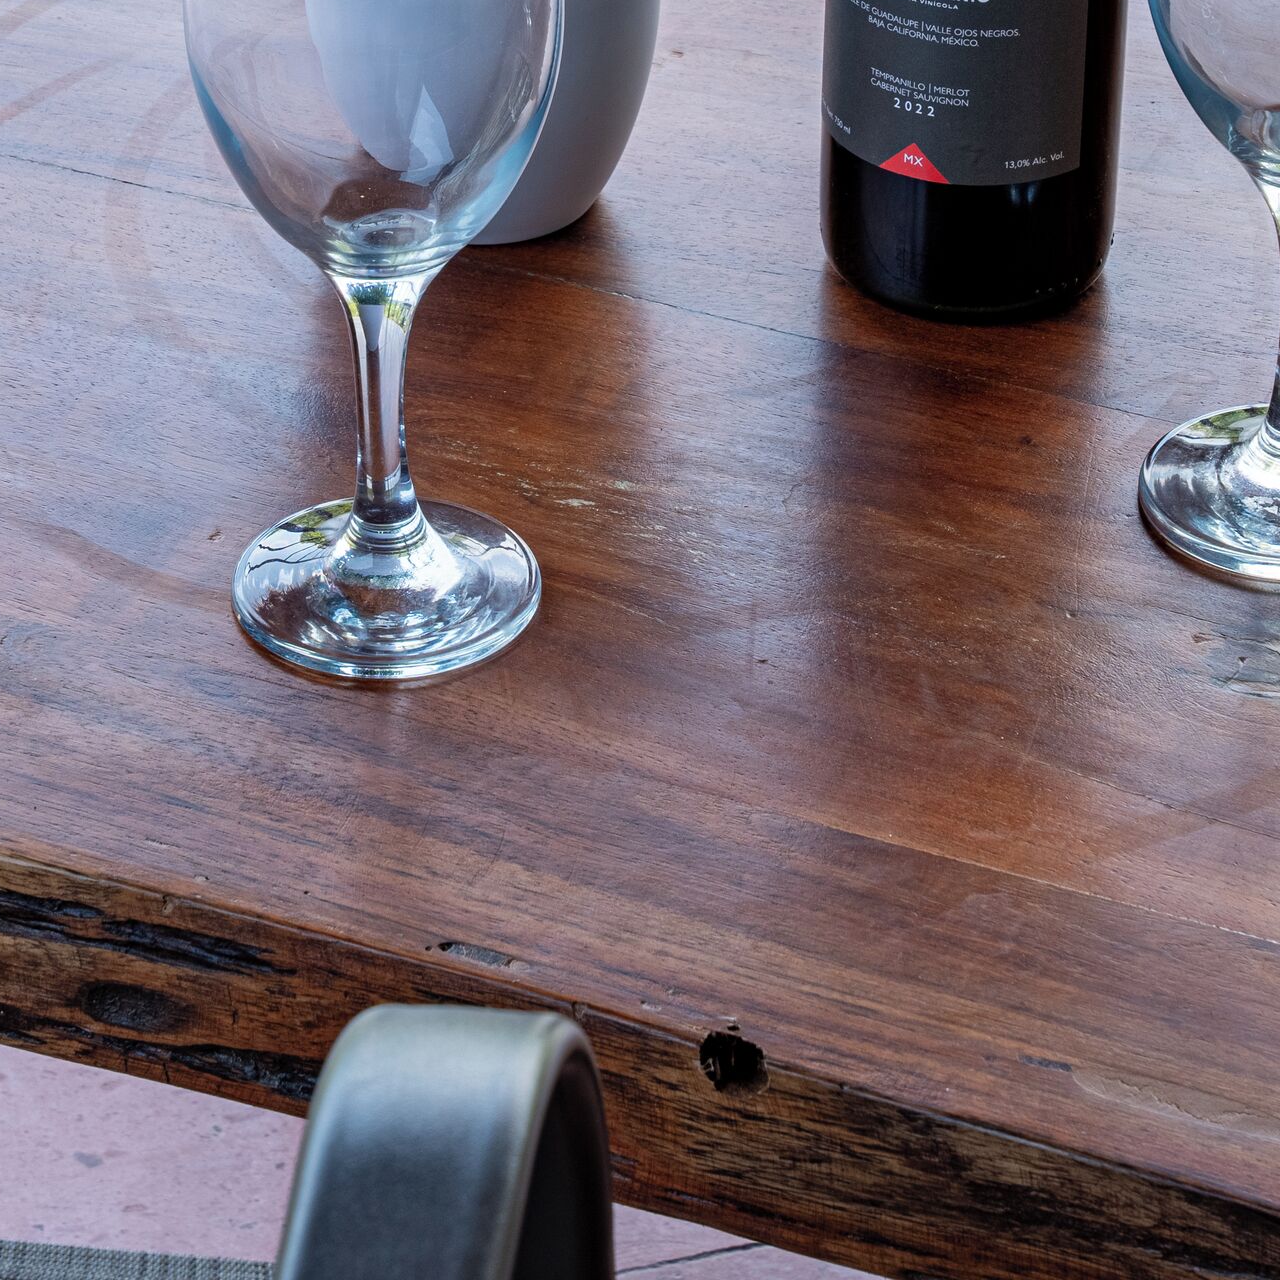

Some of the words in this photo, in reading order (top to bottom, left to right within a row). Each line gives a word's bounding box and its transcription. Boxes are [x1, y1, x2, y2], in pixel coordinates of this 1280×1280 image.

[860, 0, 870, 12] DE
[871, 7, 919, 29] GUADALUPE
[925, 23, 952, 35] VALLE
[953, 28, 978, 38] OJOS
[868, 15, 885, 28] BAJA
[870, 66, 926, 91] TEMPRANILLO
[933, 85, 970, 97] MERLOT
[870, 77, 911, 97] CABERNET
[913, 91, 969, 107] SAUVIGNON
[893, 97, 935, 117] 2022
[903, 153, 923, 167] MX
[1005, 158, 1030, 170] 13,0%
[1032, 156, 1048, 166] Alc.
[1050, 151, 1065, 161] Vol.
